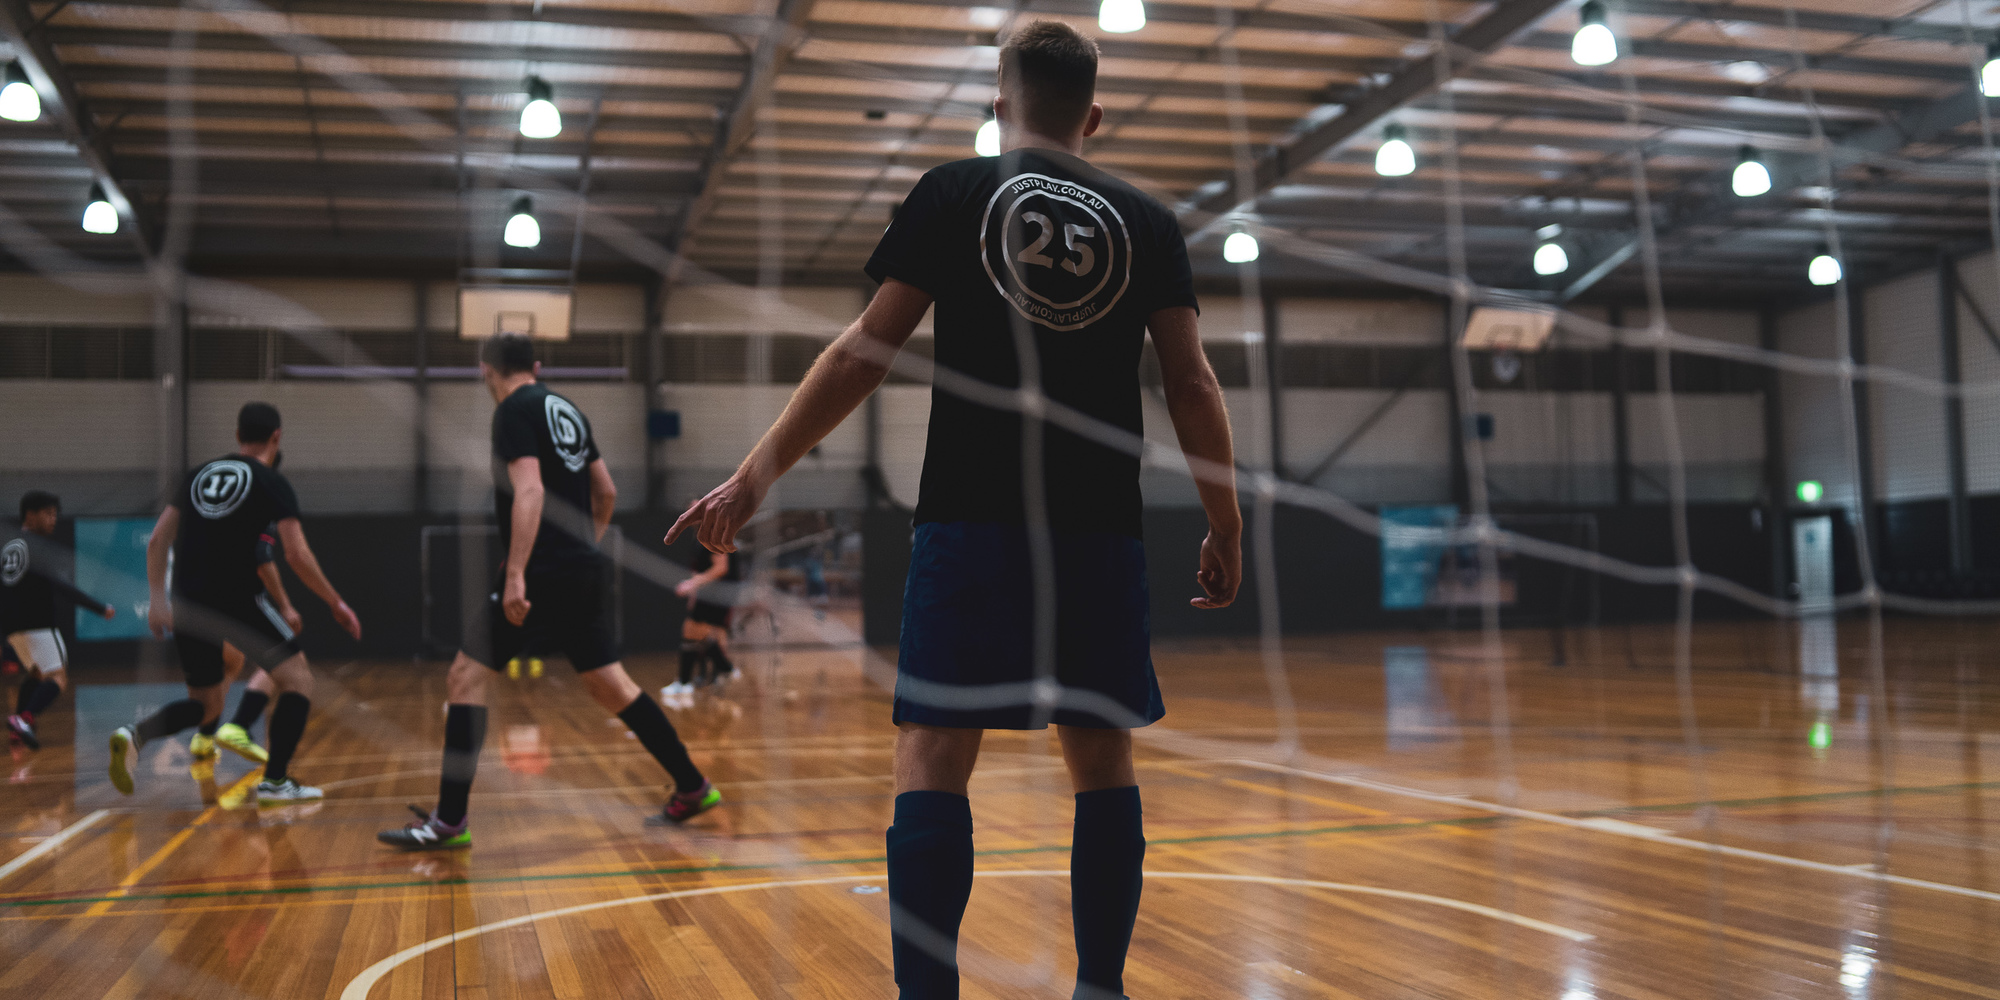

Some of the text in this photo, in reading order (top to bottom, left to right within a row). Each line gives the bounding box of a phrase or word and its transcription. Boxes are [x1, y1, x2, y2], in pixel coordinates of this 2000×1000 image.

[1011, 179, 1104, 210] JUSTPLAY.COM.AU
[1017, 211, 1095, 277] 25
[203, 474, 237, 498] 17
